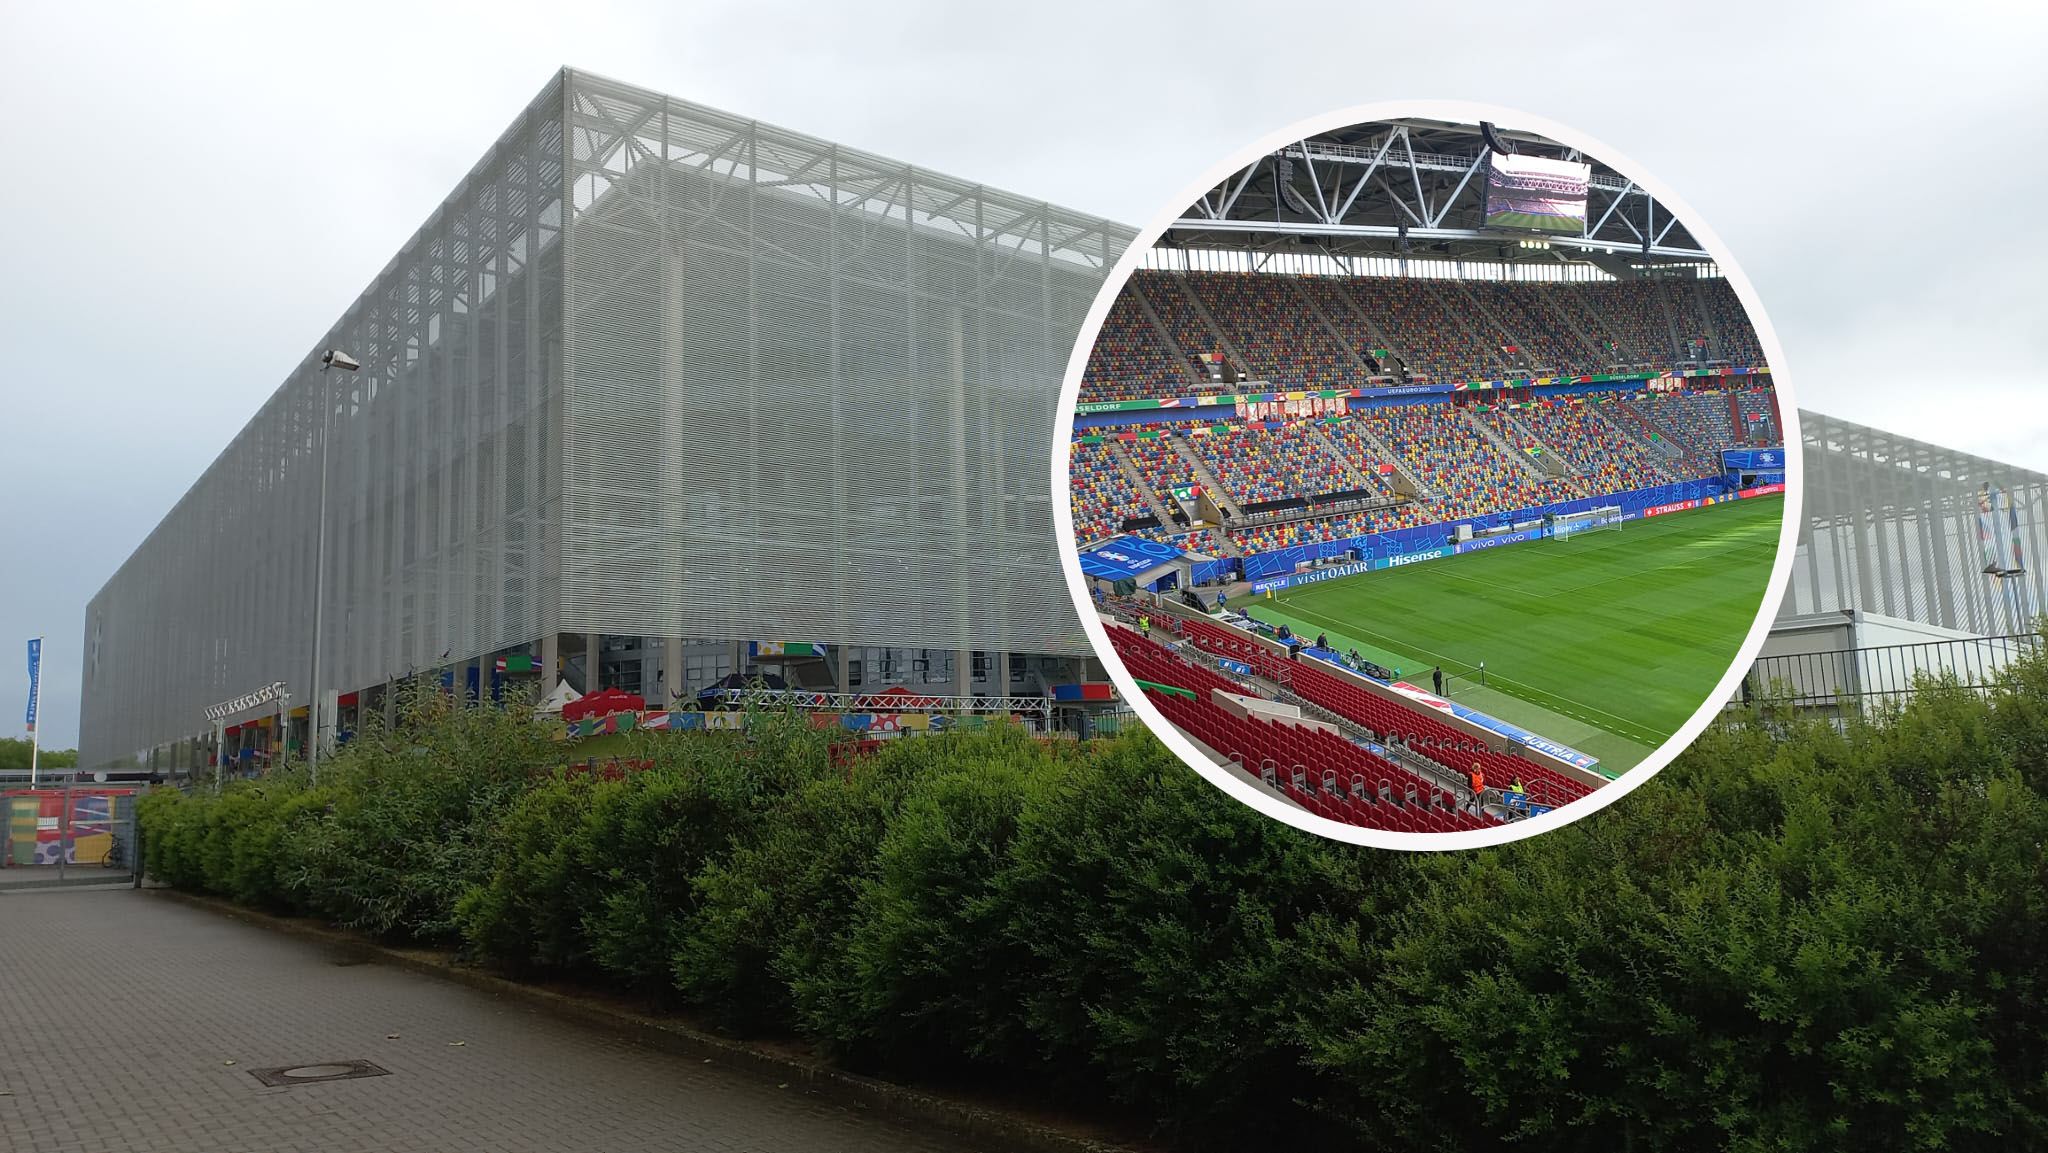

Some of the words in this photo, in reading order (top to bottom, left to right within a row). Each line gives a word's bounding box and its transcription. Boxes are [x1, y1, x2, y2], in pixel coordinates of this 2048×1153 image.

[1655, 502, 1684, 515] STRAUSS
[1389, 549, 1442, 567] Hisense
[1255, 579, 1286, 591] RECYCLE
